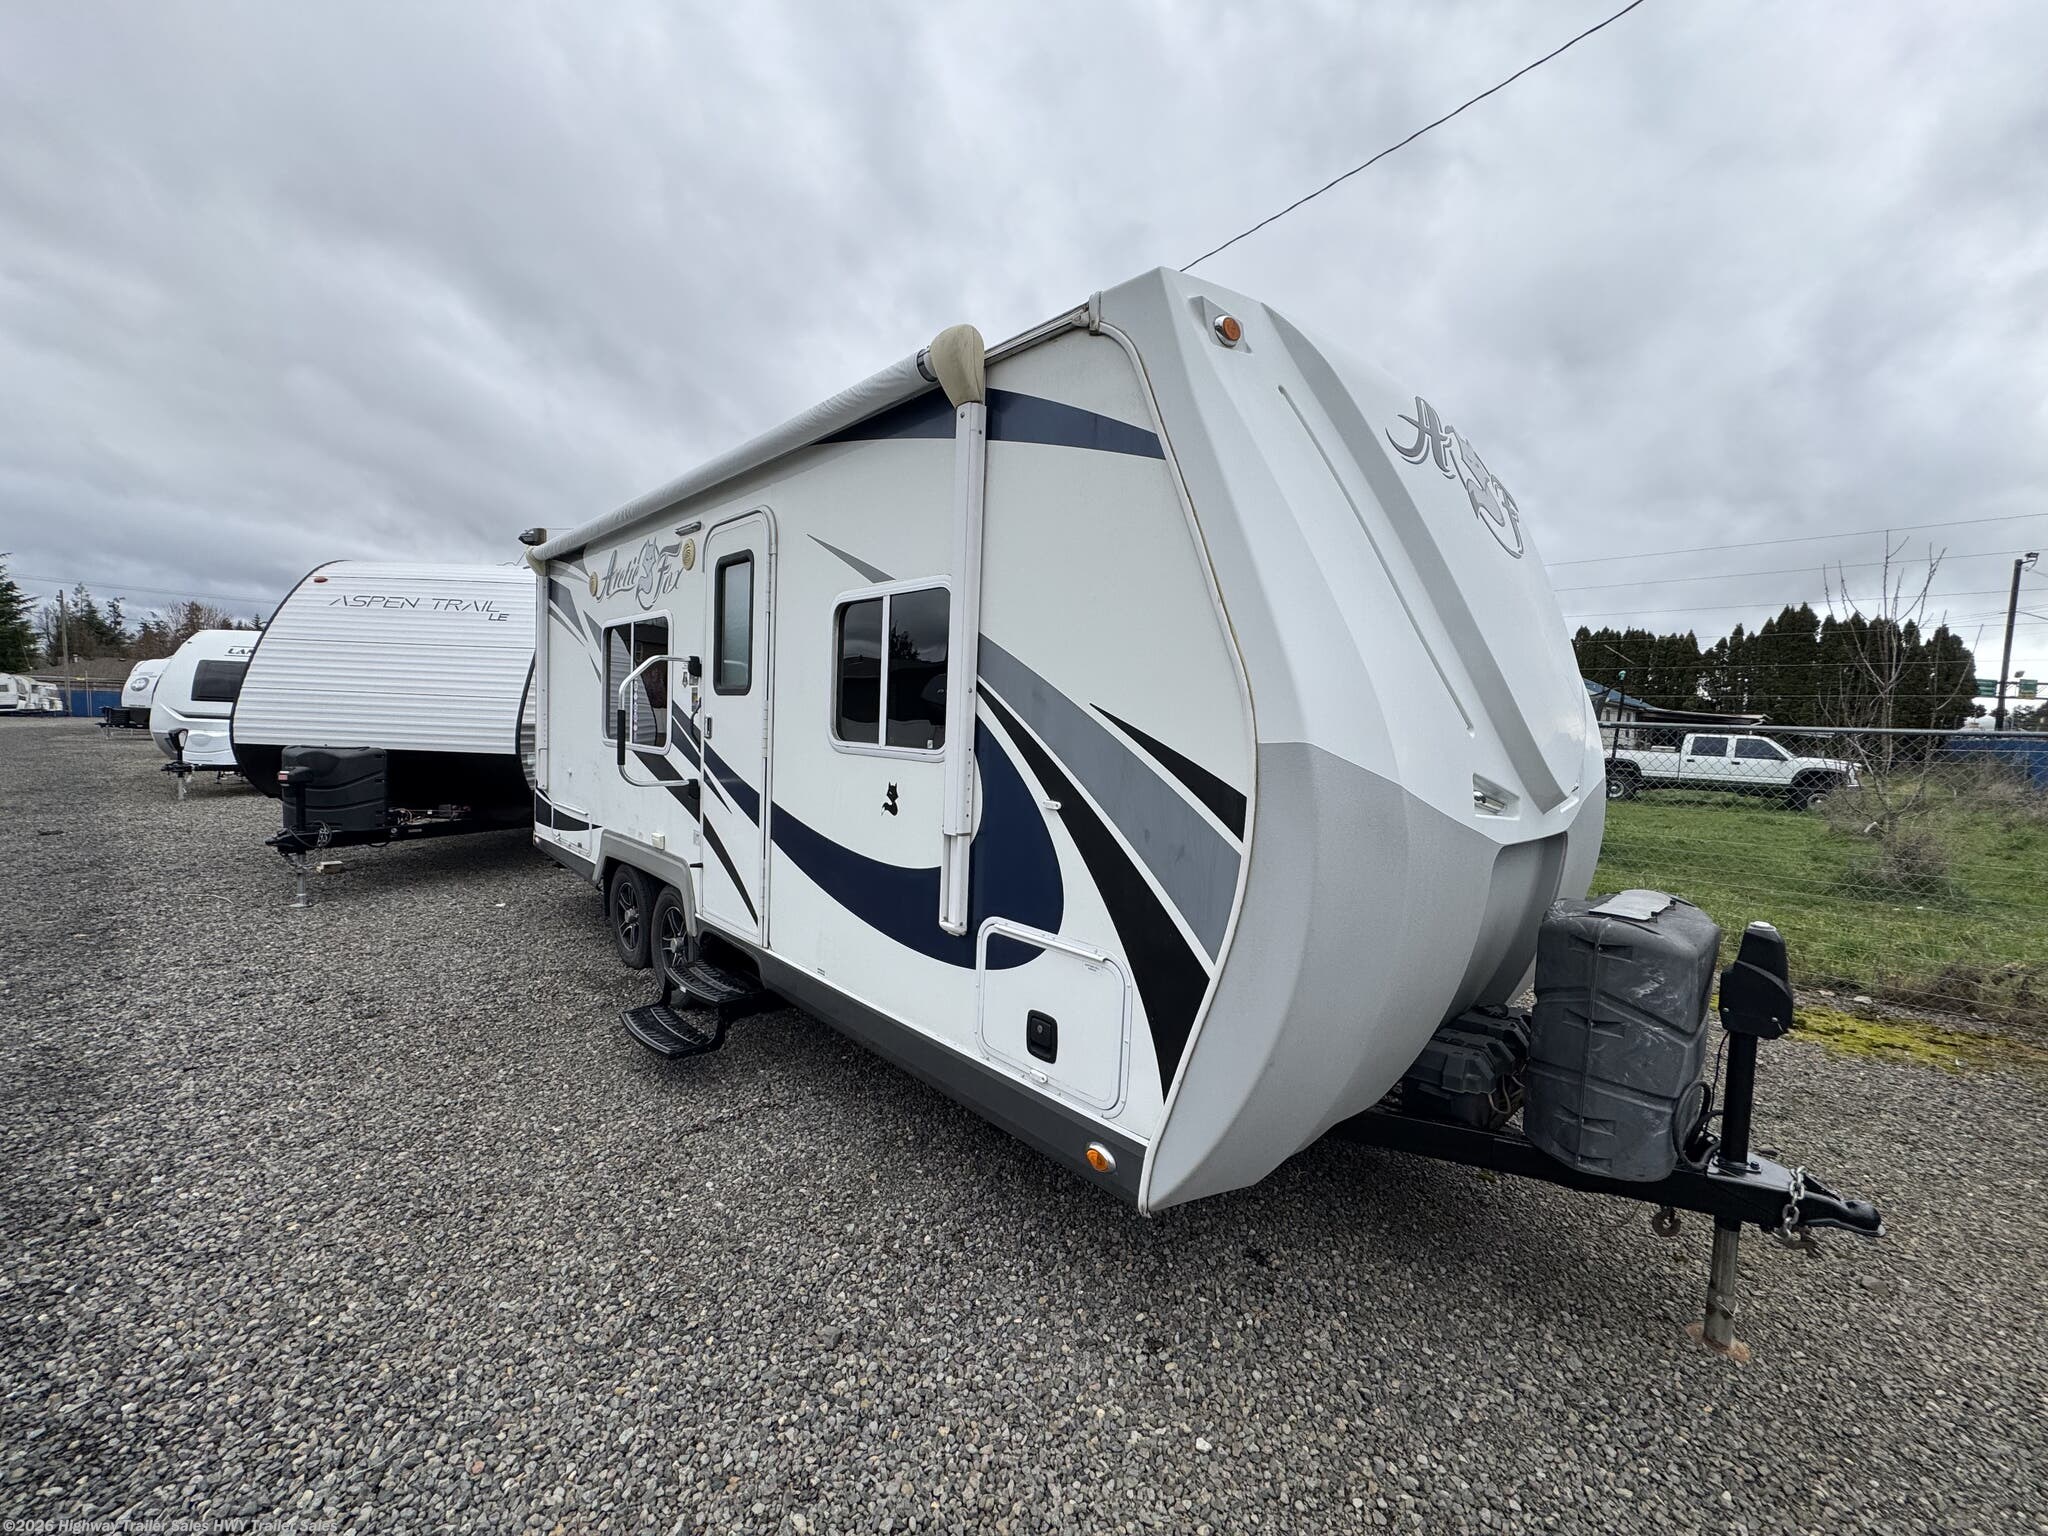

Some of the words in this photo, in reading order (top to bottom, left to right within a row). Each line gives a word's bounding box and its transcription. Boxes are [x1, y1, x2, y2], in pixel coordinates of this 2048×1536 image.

[329, 595, 420, 609] ASPEN
[431, 597, 500, 613] TRAIL
[488, 613, 510, 621] LE
